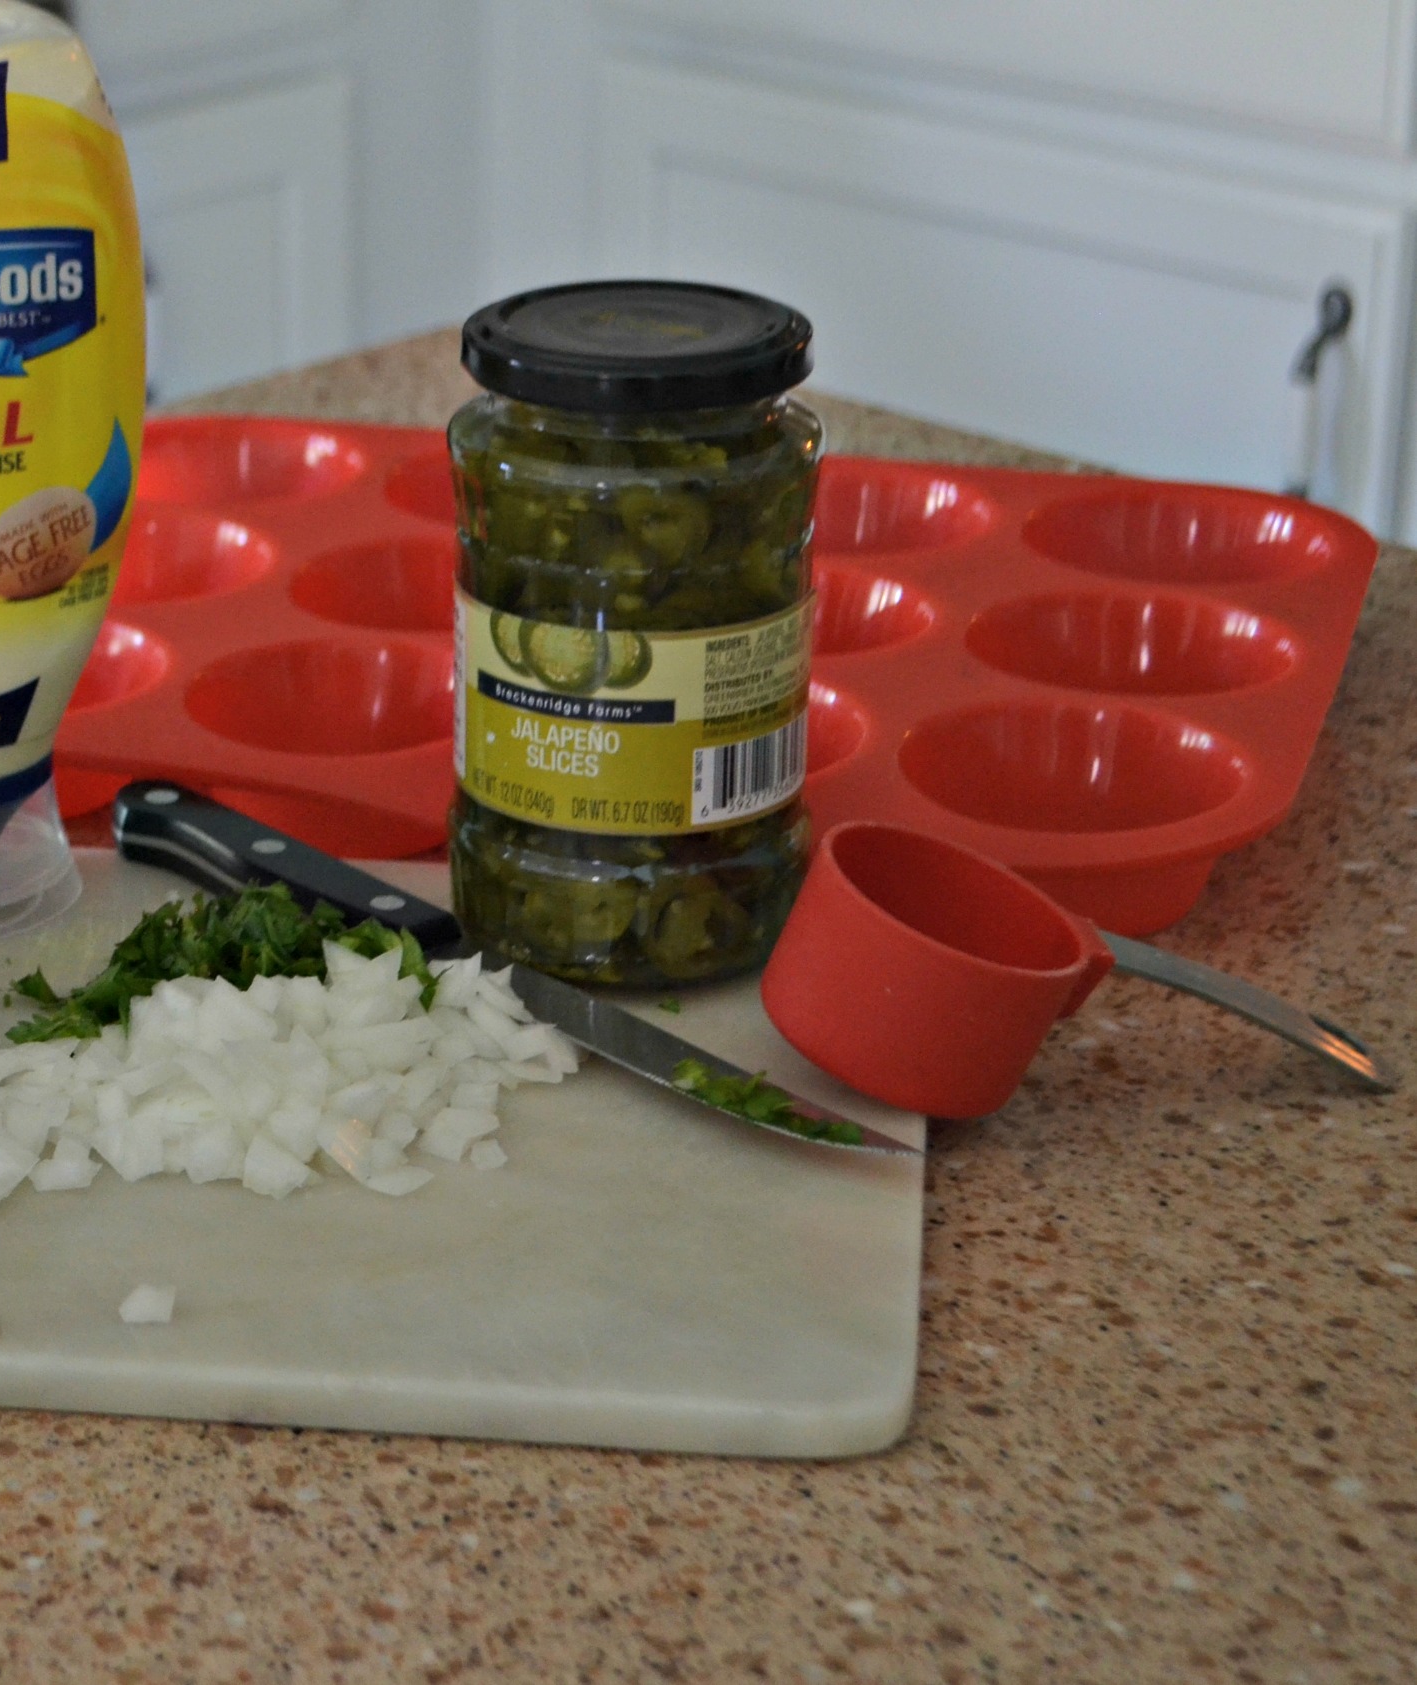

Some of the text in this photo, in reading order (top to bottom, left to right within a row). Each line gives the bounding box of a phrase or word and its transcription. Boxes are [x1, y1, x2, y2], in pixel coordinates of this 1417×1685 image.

[48, 504, 92, 548] FREE
[18, 548, 70, 587] EGGS
[495, 683, 582, 717] Breckenridge
[511, 716, 622, 755] JALAPEÑO
[526, 745, 601, 779] SLICES
[632, 801, 648, 825] OZ
